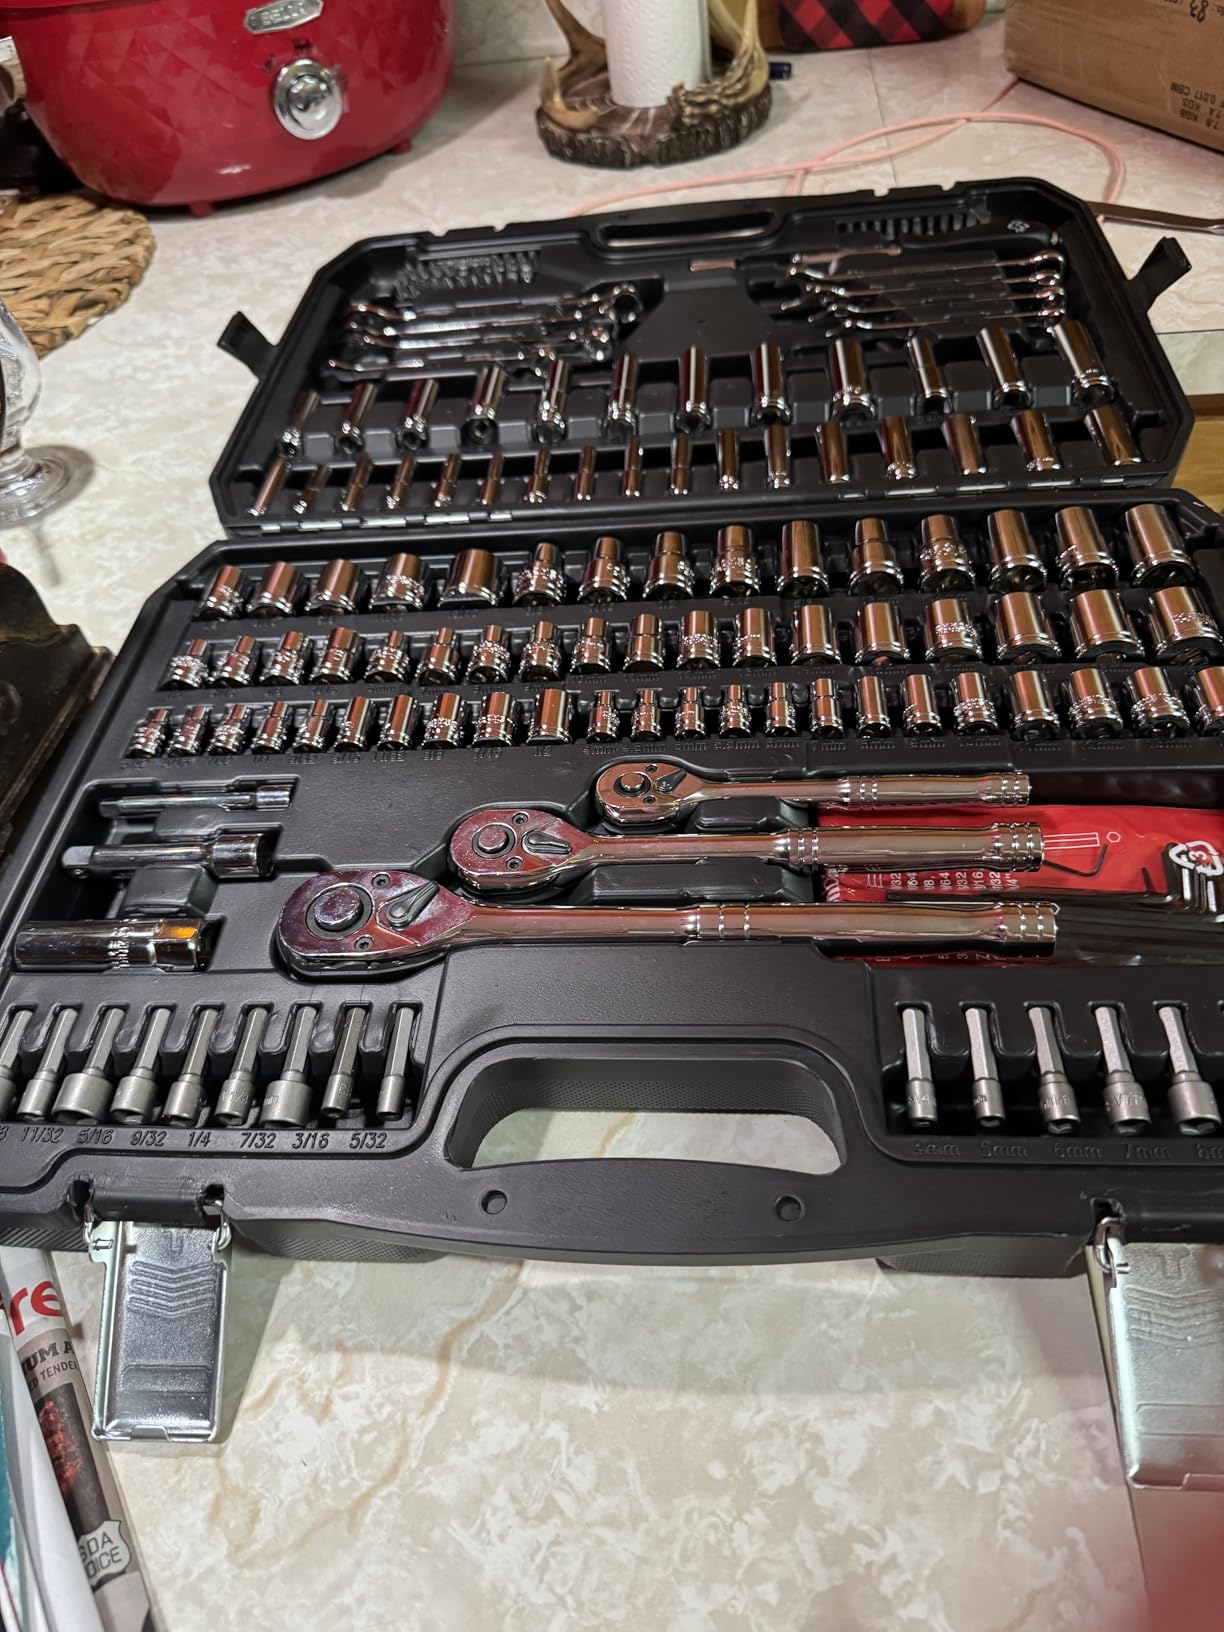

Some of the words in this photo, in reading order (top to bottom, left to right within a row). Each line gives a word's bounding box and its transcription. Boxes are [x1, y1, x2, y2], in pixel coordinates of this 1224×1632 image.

[22, 1128, 63, 1144] 11/32
[78, 1129, 115, 1145] 5/16
[130, 1130, 167, 1146] 9/32
[188, 1131, 212, 1147] 1/4
[240, 1132, 277, 1149] 7/32
[292, 1132, 329, 1149] 3/16
[349, 1132, 388, 1149] 5/32
[980, 1141, 1029, 1157] 5mm
[1126, 1143, 1172, 1159] 7mm
[1196, 1143, 1224, 1159] 8m
[9, 1280, 65, 1336] re
[79, 1531, 114, 1562] SDA
[85, 1546, 122, 1578] OICE
